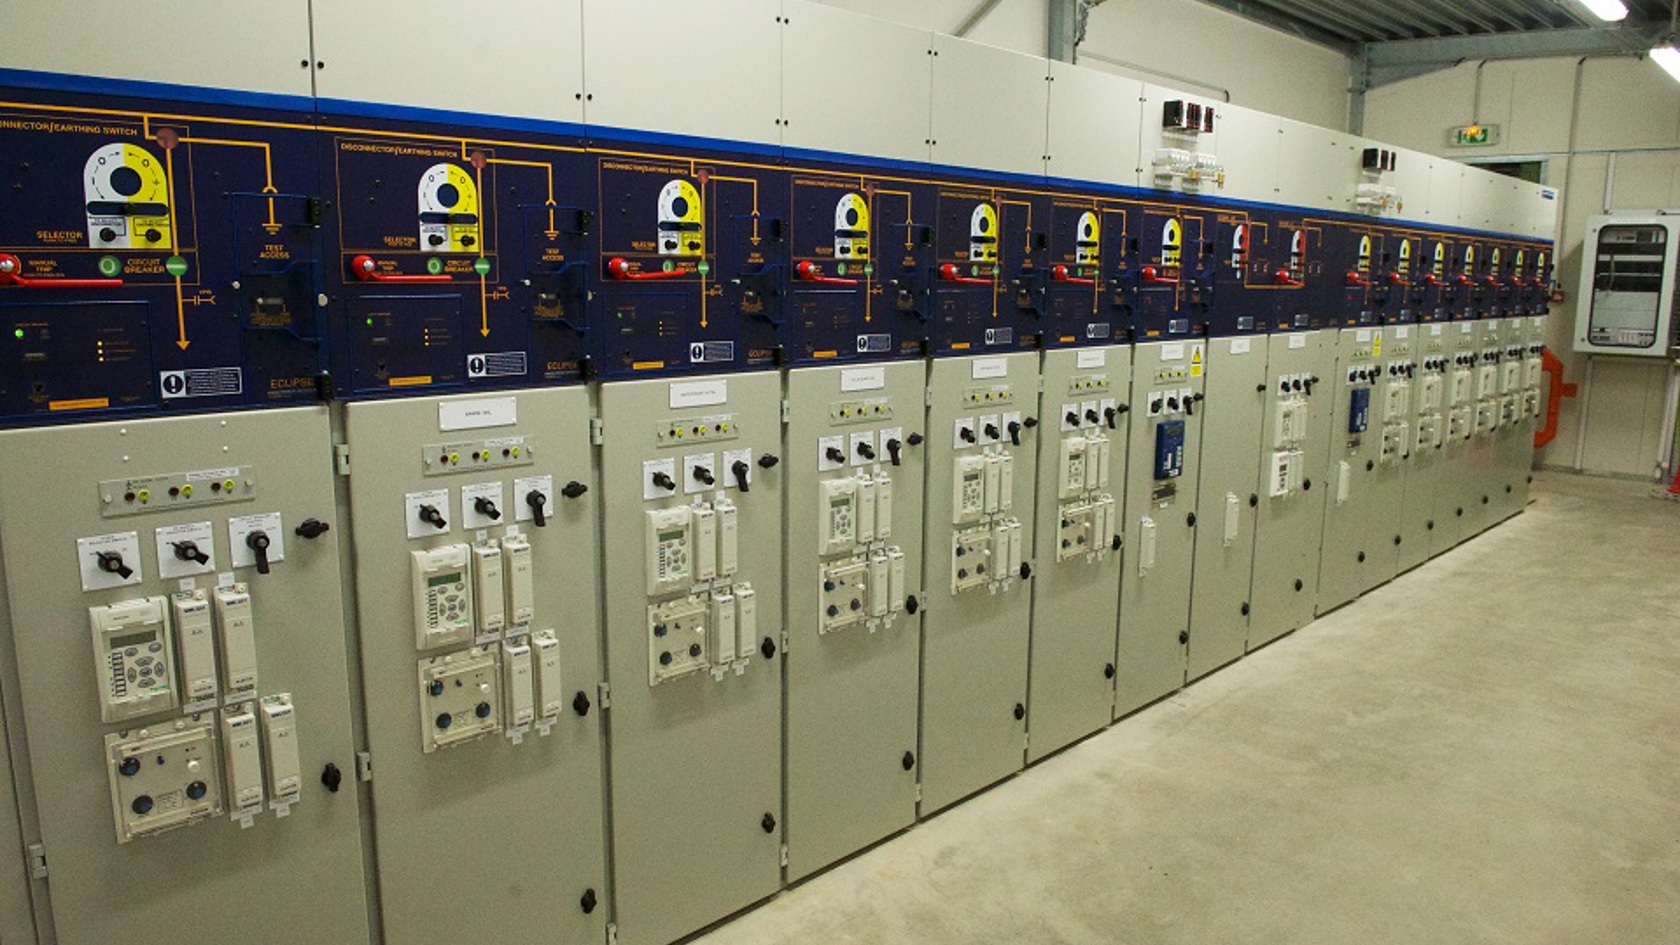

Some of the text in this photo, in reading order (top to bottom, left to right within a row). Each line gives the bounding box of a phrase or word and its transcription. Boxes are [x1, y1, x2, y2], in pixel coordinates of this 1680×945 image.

[103, 127, 137, 136] SWITCH
[37, 230, 83, 239] SELECTOR
[259, 251, 290, 259] ACCESS
[127, 258, 161, 266] CIRCUIT
[124, 266, 165, 274] BREAKER
